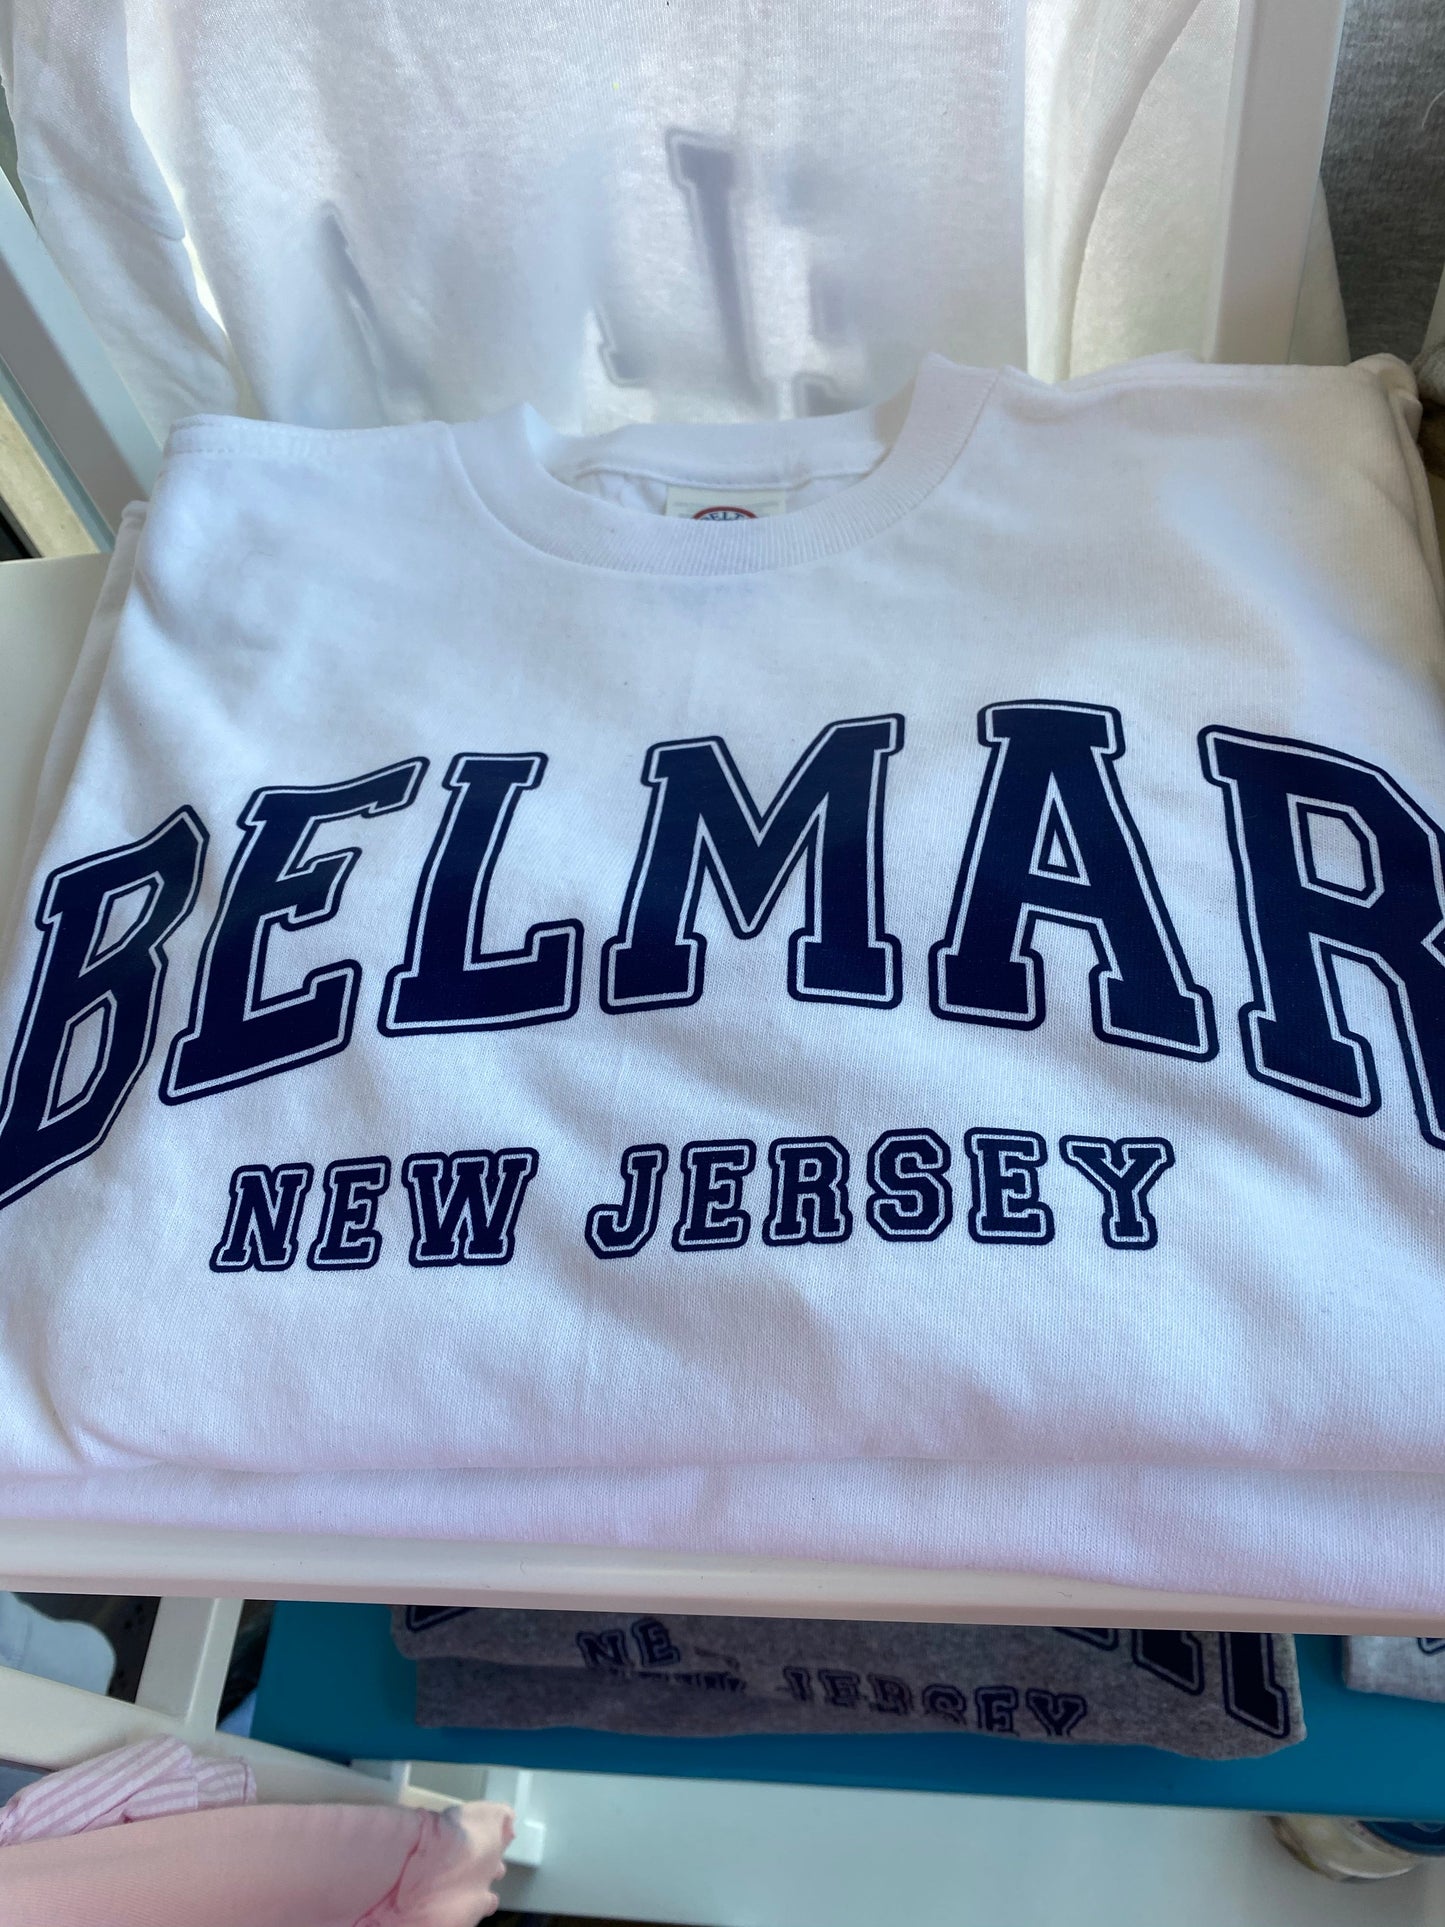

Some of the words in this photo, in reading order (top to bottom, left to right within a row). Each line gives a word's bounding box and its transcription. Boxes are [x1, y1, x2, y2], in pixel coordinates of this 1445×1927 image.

[0, 699, 1445, 1210] BELMAR
[209, 1147, 539, 1273] NEW
[584, 1127, 1175, 1259] JERSEY
[576, 1617, 741, 1674] NE
